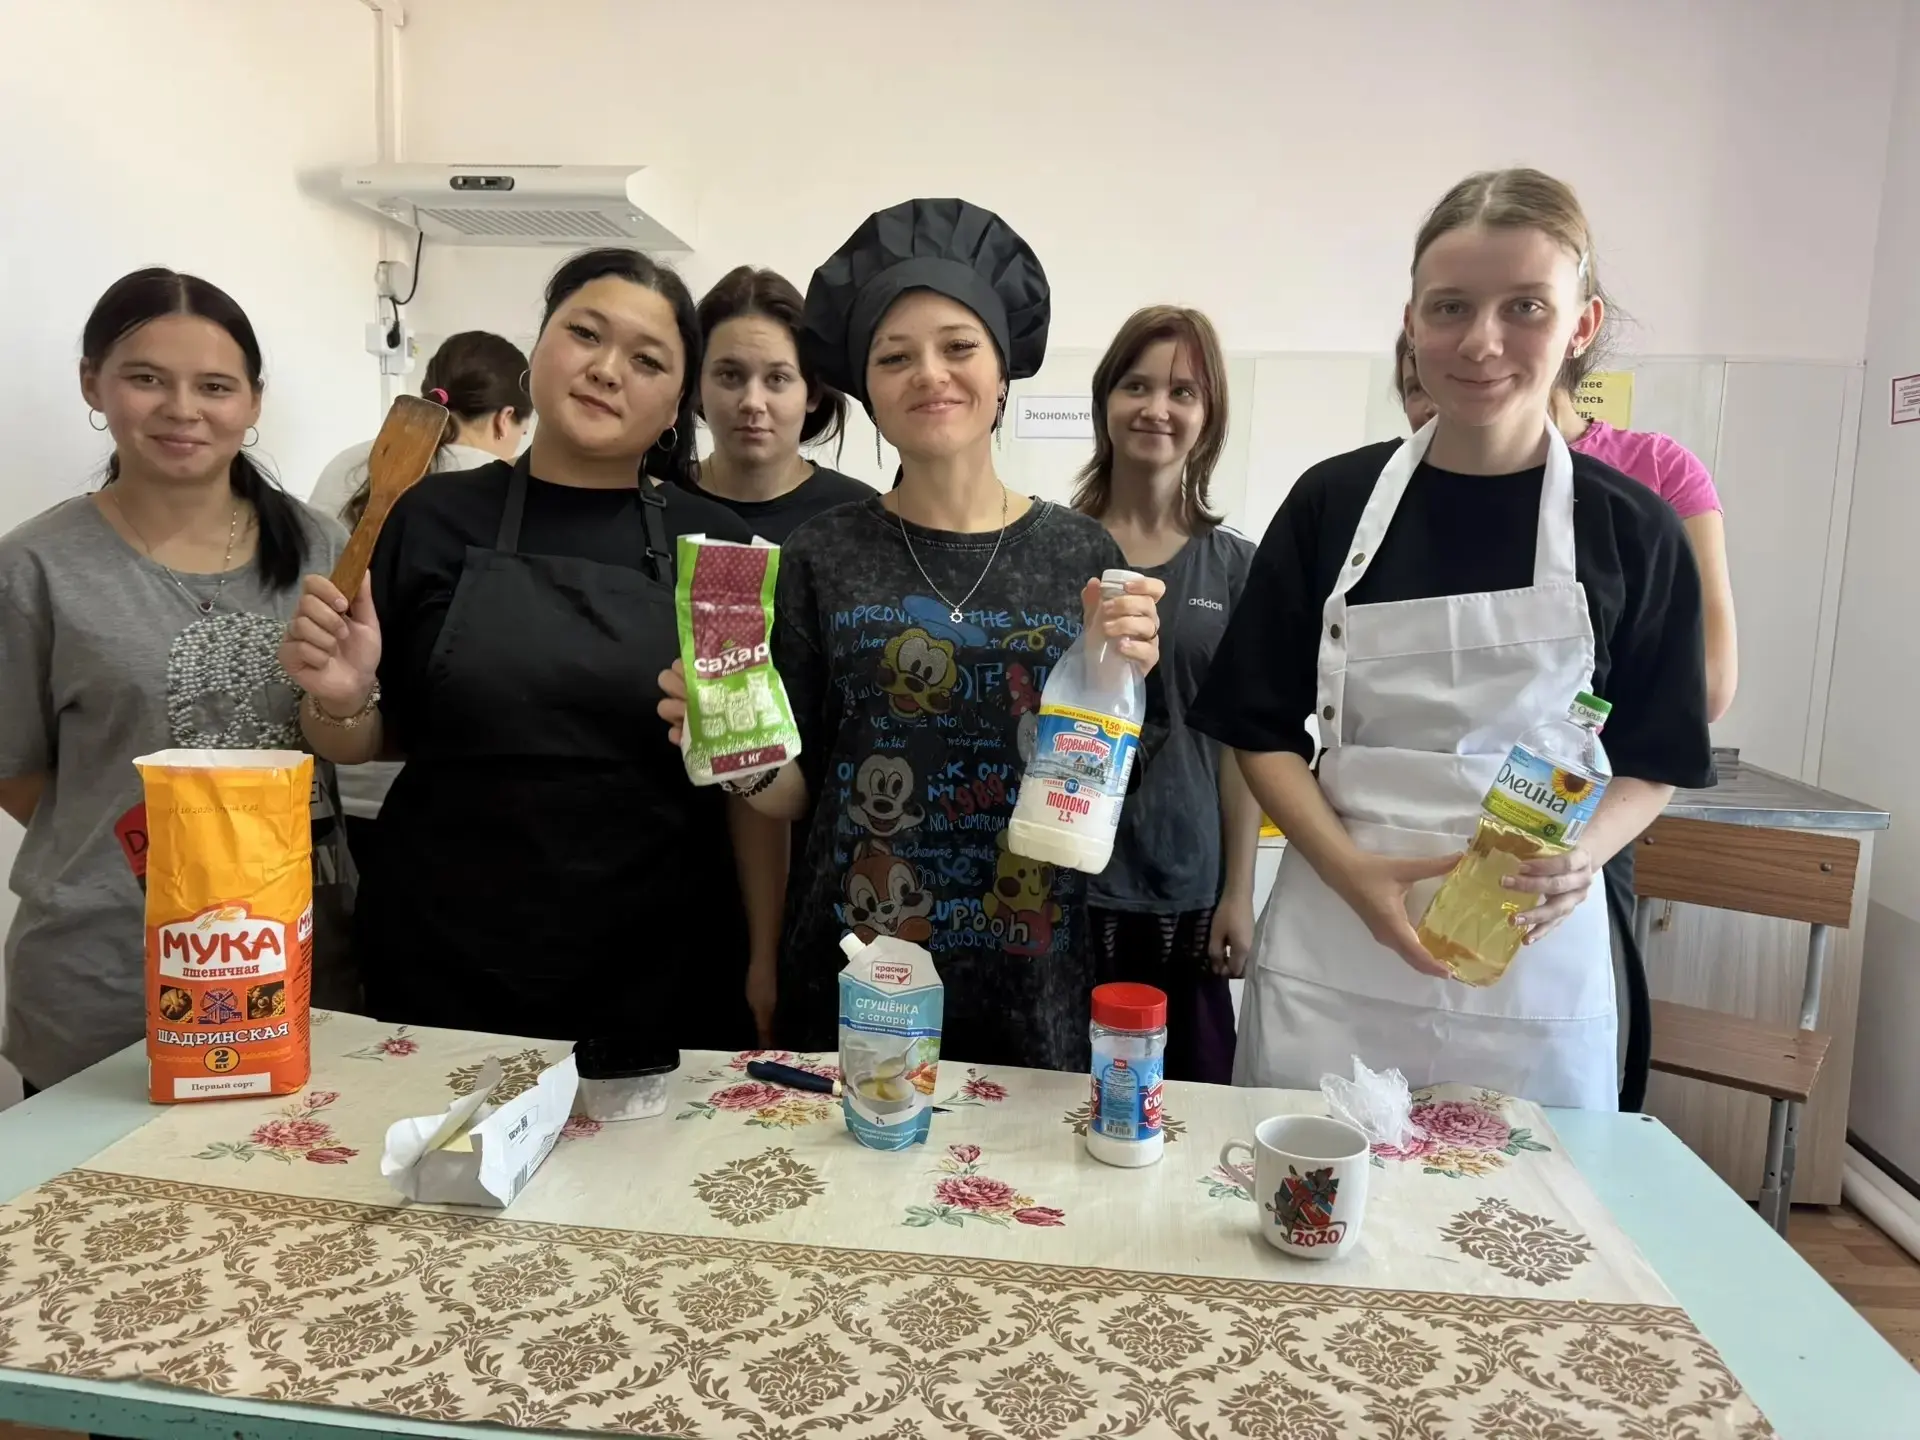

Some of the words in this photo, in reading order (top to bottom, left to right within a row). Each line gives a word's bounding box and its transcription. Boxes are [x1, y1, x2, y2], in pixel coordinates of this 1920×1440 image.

[1024, 409, 1091, 421] Экономьте
[694, 642, 770, 673] сахар
[1496, 763, 1568, 815] Олейна
[163, 926, 282, 966] МУКА
[181, 964, 260, 979] пшеничная
[874, 972, 895, 981] цена
[875, 965, 909, 975] красная
[855, 997, 919, 1016] СГУЩЁНКА
[867, 1013, 914, 1027] сахаром
[157, 1022, 289, 1048] ШАДРИНСКАЯ
[214, 1050, 230, 1064] 2
[191, 1081, 231, 1092] Первый
[232, 1080, 255, 1091] сорт
[1292, 1229, 1340, 1248] 2020
